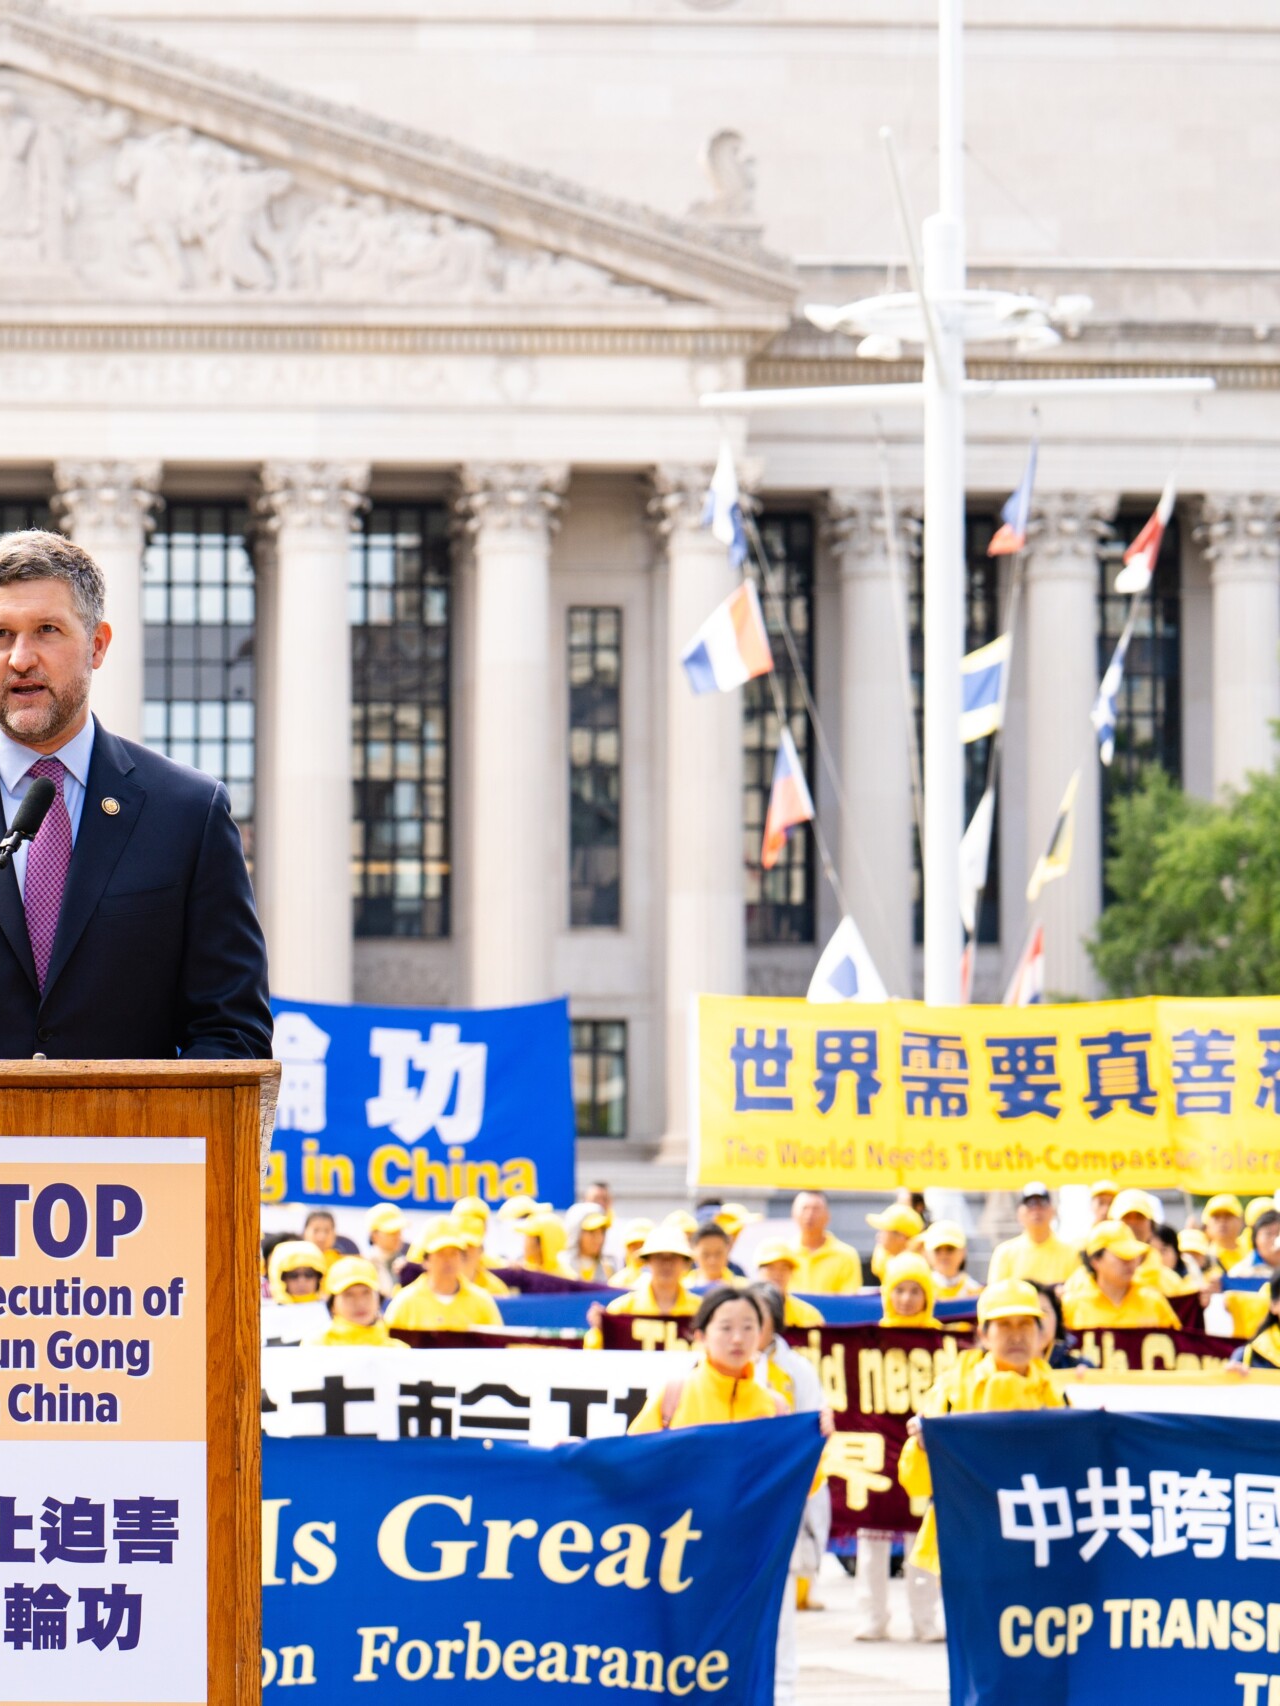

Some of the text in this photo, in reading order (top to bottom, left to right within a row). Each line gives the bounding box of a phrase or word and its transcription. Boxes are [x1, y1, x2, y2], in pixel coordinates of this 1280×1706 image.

[66, 358, 194, 393] STATES
[209, 358, 257, 395] OF
[269, 358, 451, 393] AMERICA
[302, 1138, 355, 1197] in
[368, 1143, 538, 1202] China
[723, 1137, 767, 1168] The
[776, 1138, 854, 1170] World
[866, 1138, 948, 1171] Needs
[149, 1277, 184, 1315] of
[47, 1330, 151, 1376] Gong
[8, 1383, 118, 1422] China
[262, 1494, 702, 1594] Is Great
[999, 1603, 1093, 1657] CCP
[353, 1621, 730, 1696] Forbearance
